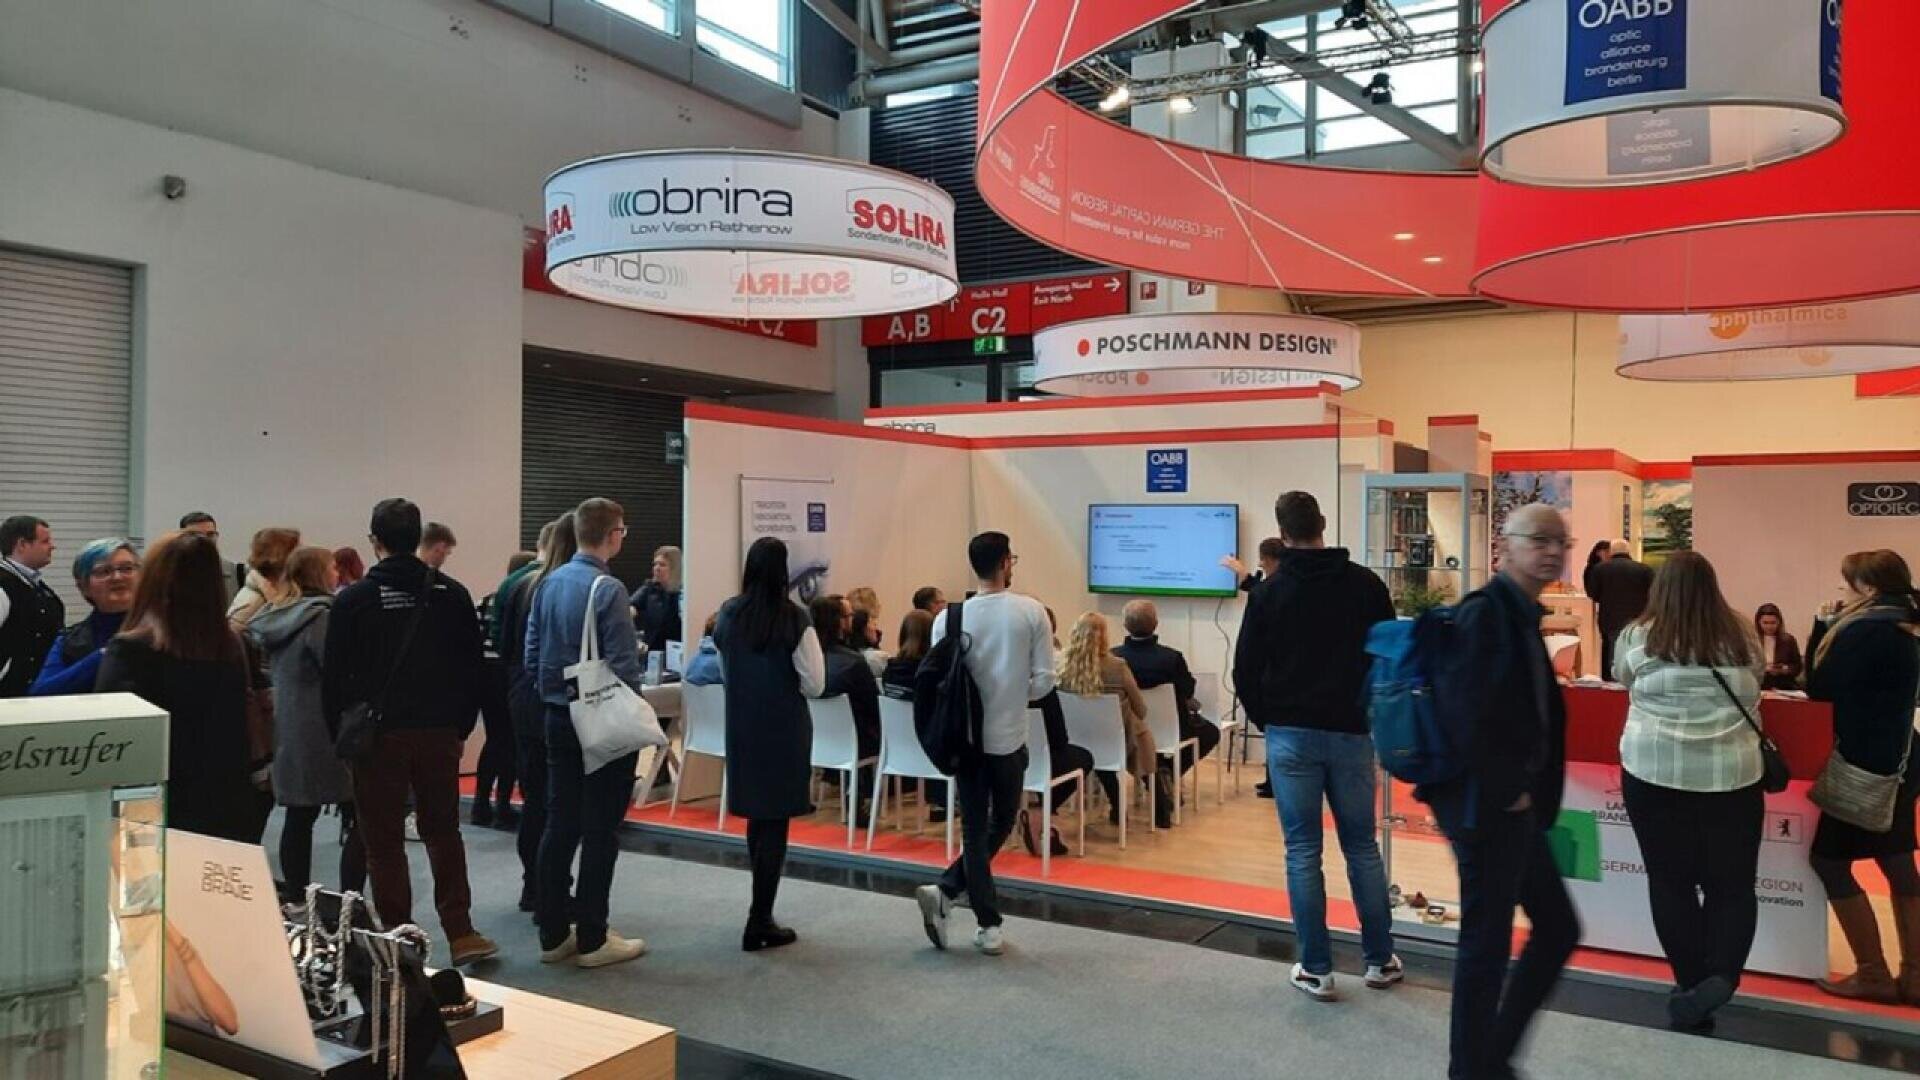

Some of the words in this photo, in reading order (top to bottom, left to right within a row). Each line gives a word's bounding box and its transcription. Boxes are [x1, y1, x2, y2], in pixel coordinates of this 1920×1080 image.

[1578, 0, 1675, 28] OABB
[1609, 30, 1642, 43] optic
[1600, 44, 1652, 60] alliance
[1583, 57, 1668, 77] brandenburg
[1607, 75, 1643, 88] berlin
[632, 176, 793, 217] obrira
[630, 223, 661, 235] Low
[661, 220, 707, 233] Vision
[709, 220, 793, 235] Rathenow
[853, 198, 946, 249] SOLIRA
[888, 314, 932, 342] A,B
[970, 306, 1006, 334] C2
[1096, 331, 1251, 354] POSCHMANN
